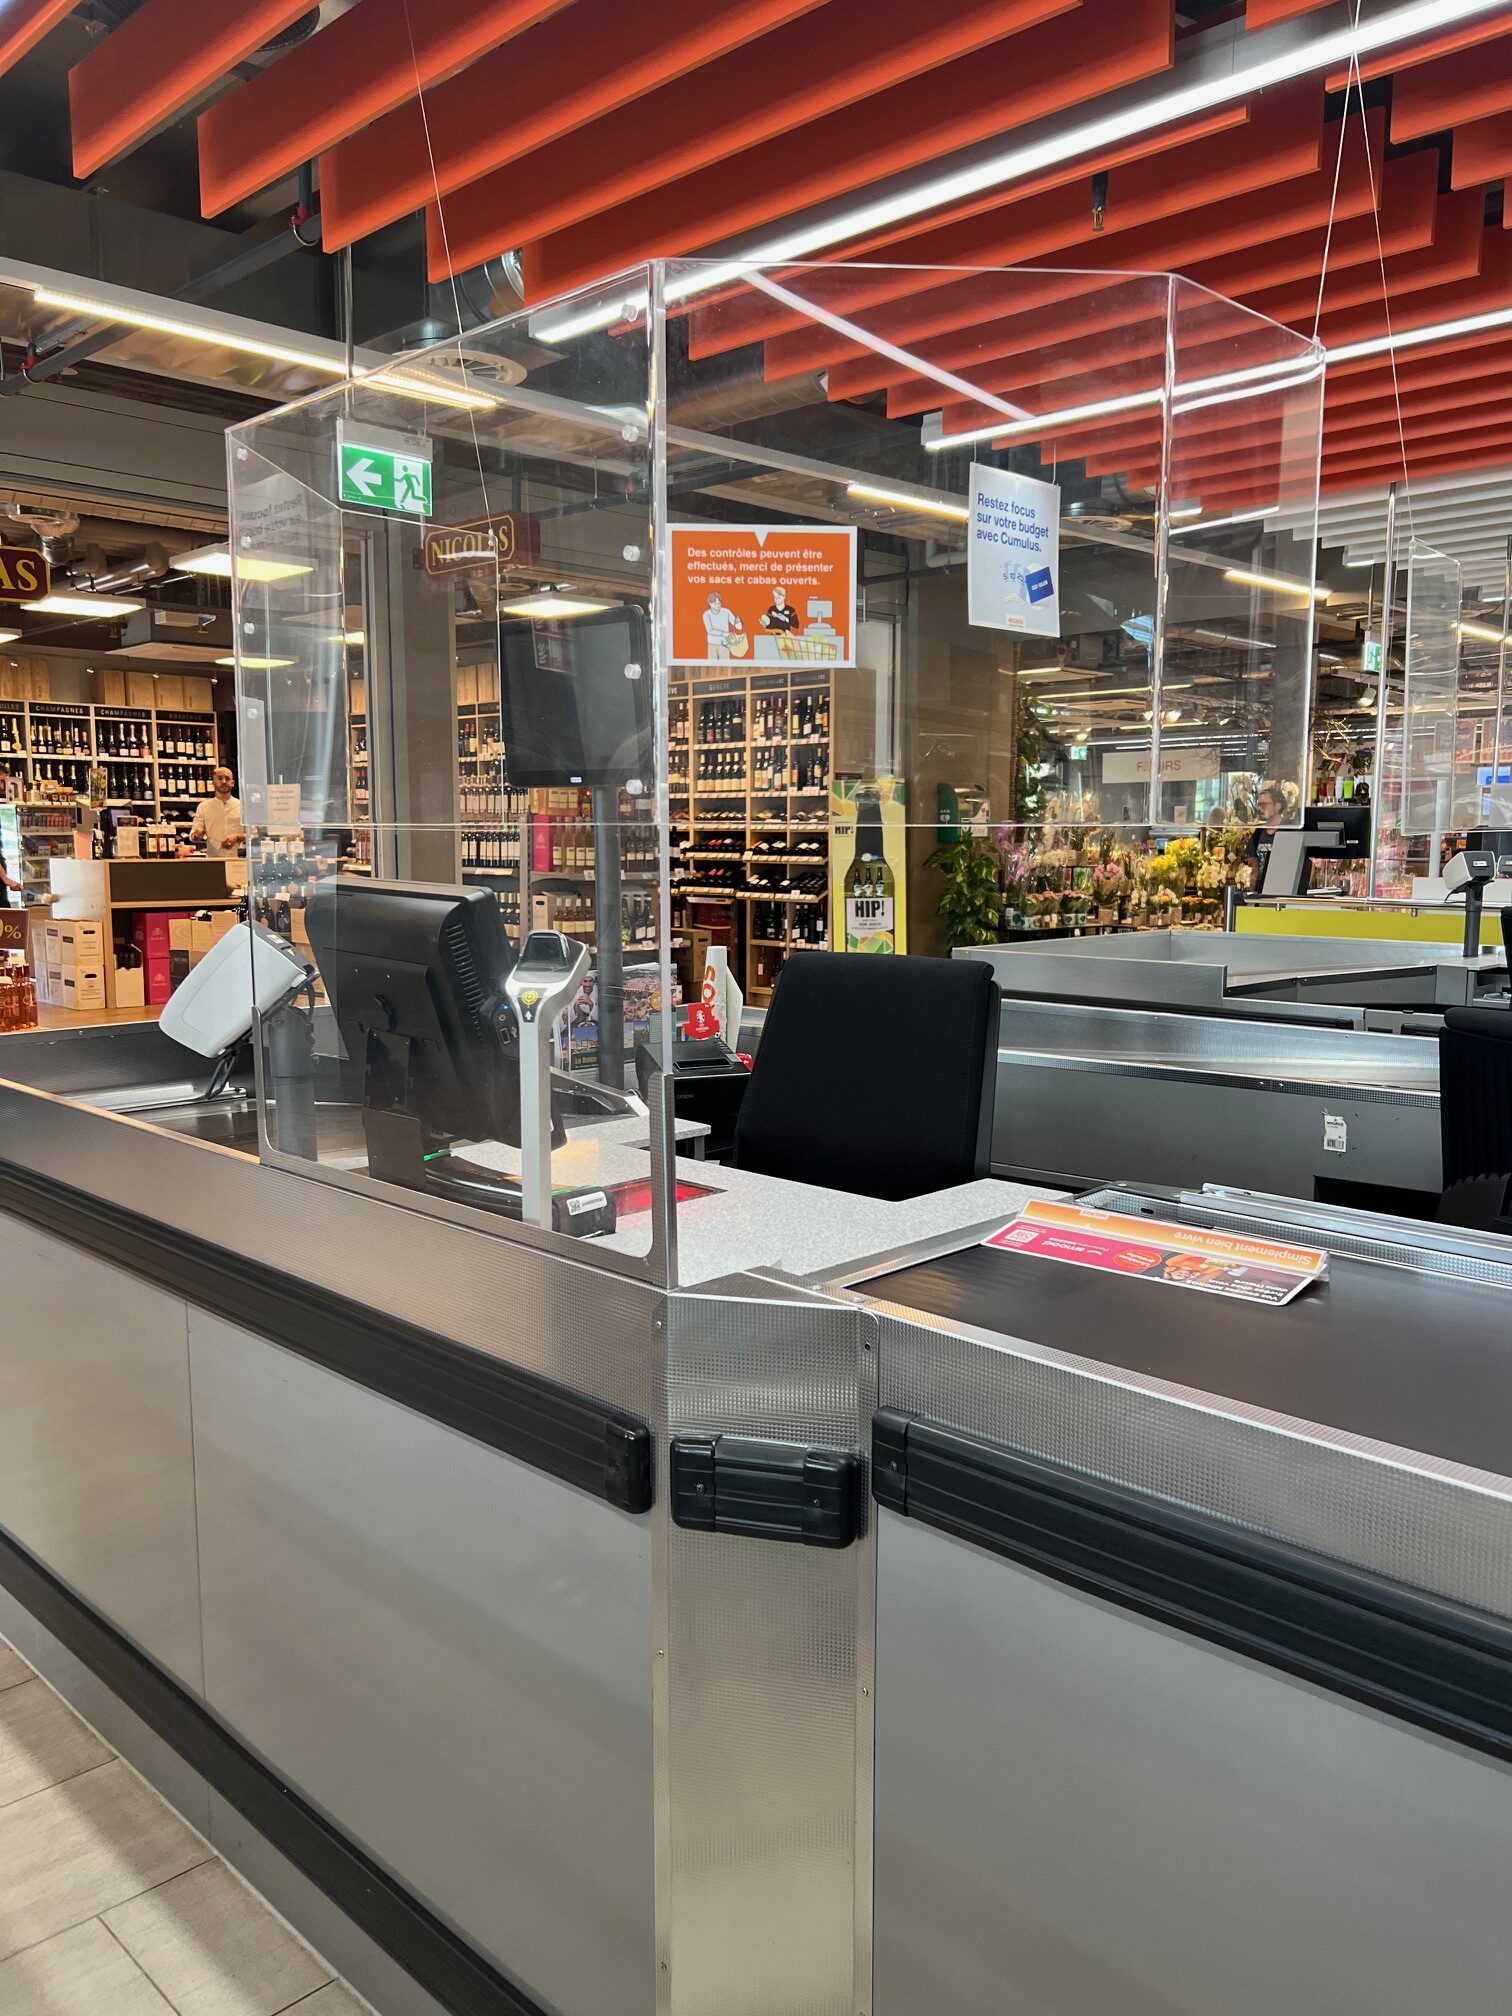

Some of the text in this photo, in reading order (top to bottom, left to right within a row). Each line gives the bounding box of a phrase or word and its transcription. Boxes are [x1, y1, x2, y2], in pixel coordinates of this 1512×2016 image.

[977, 492, 1036, 519] Restez focus
[976, 512, 1049, 539] sur votre budget
[431, 525, 508, 566] NICOLS
[976, 528, 1042, 553] avec Cumulus.
[687, 547, 823, 560] Des contrôles peuvent être
[687, 561, 834, 574] effectués, merci de présenter
[687, 575, 821, 586] vos sacs et cabas ouverts.
[35, 705, 84, 714] CHAMPAGNES
[100, 709, 146, 718] CHAMPAGNES
[834, 825, 854, 835] HIP!
[855, 900, 885, 918] HIP!
[1173, 1231, 1313, 1265] Simplement bien vivre
[1224, 1286, 1260, 1298] courses
[1265, 1284, 1288, 1292] dans
[1260, 1293, 1278, 1302] Vos
